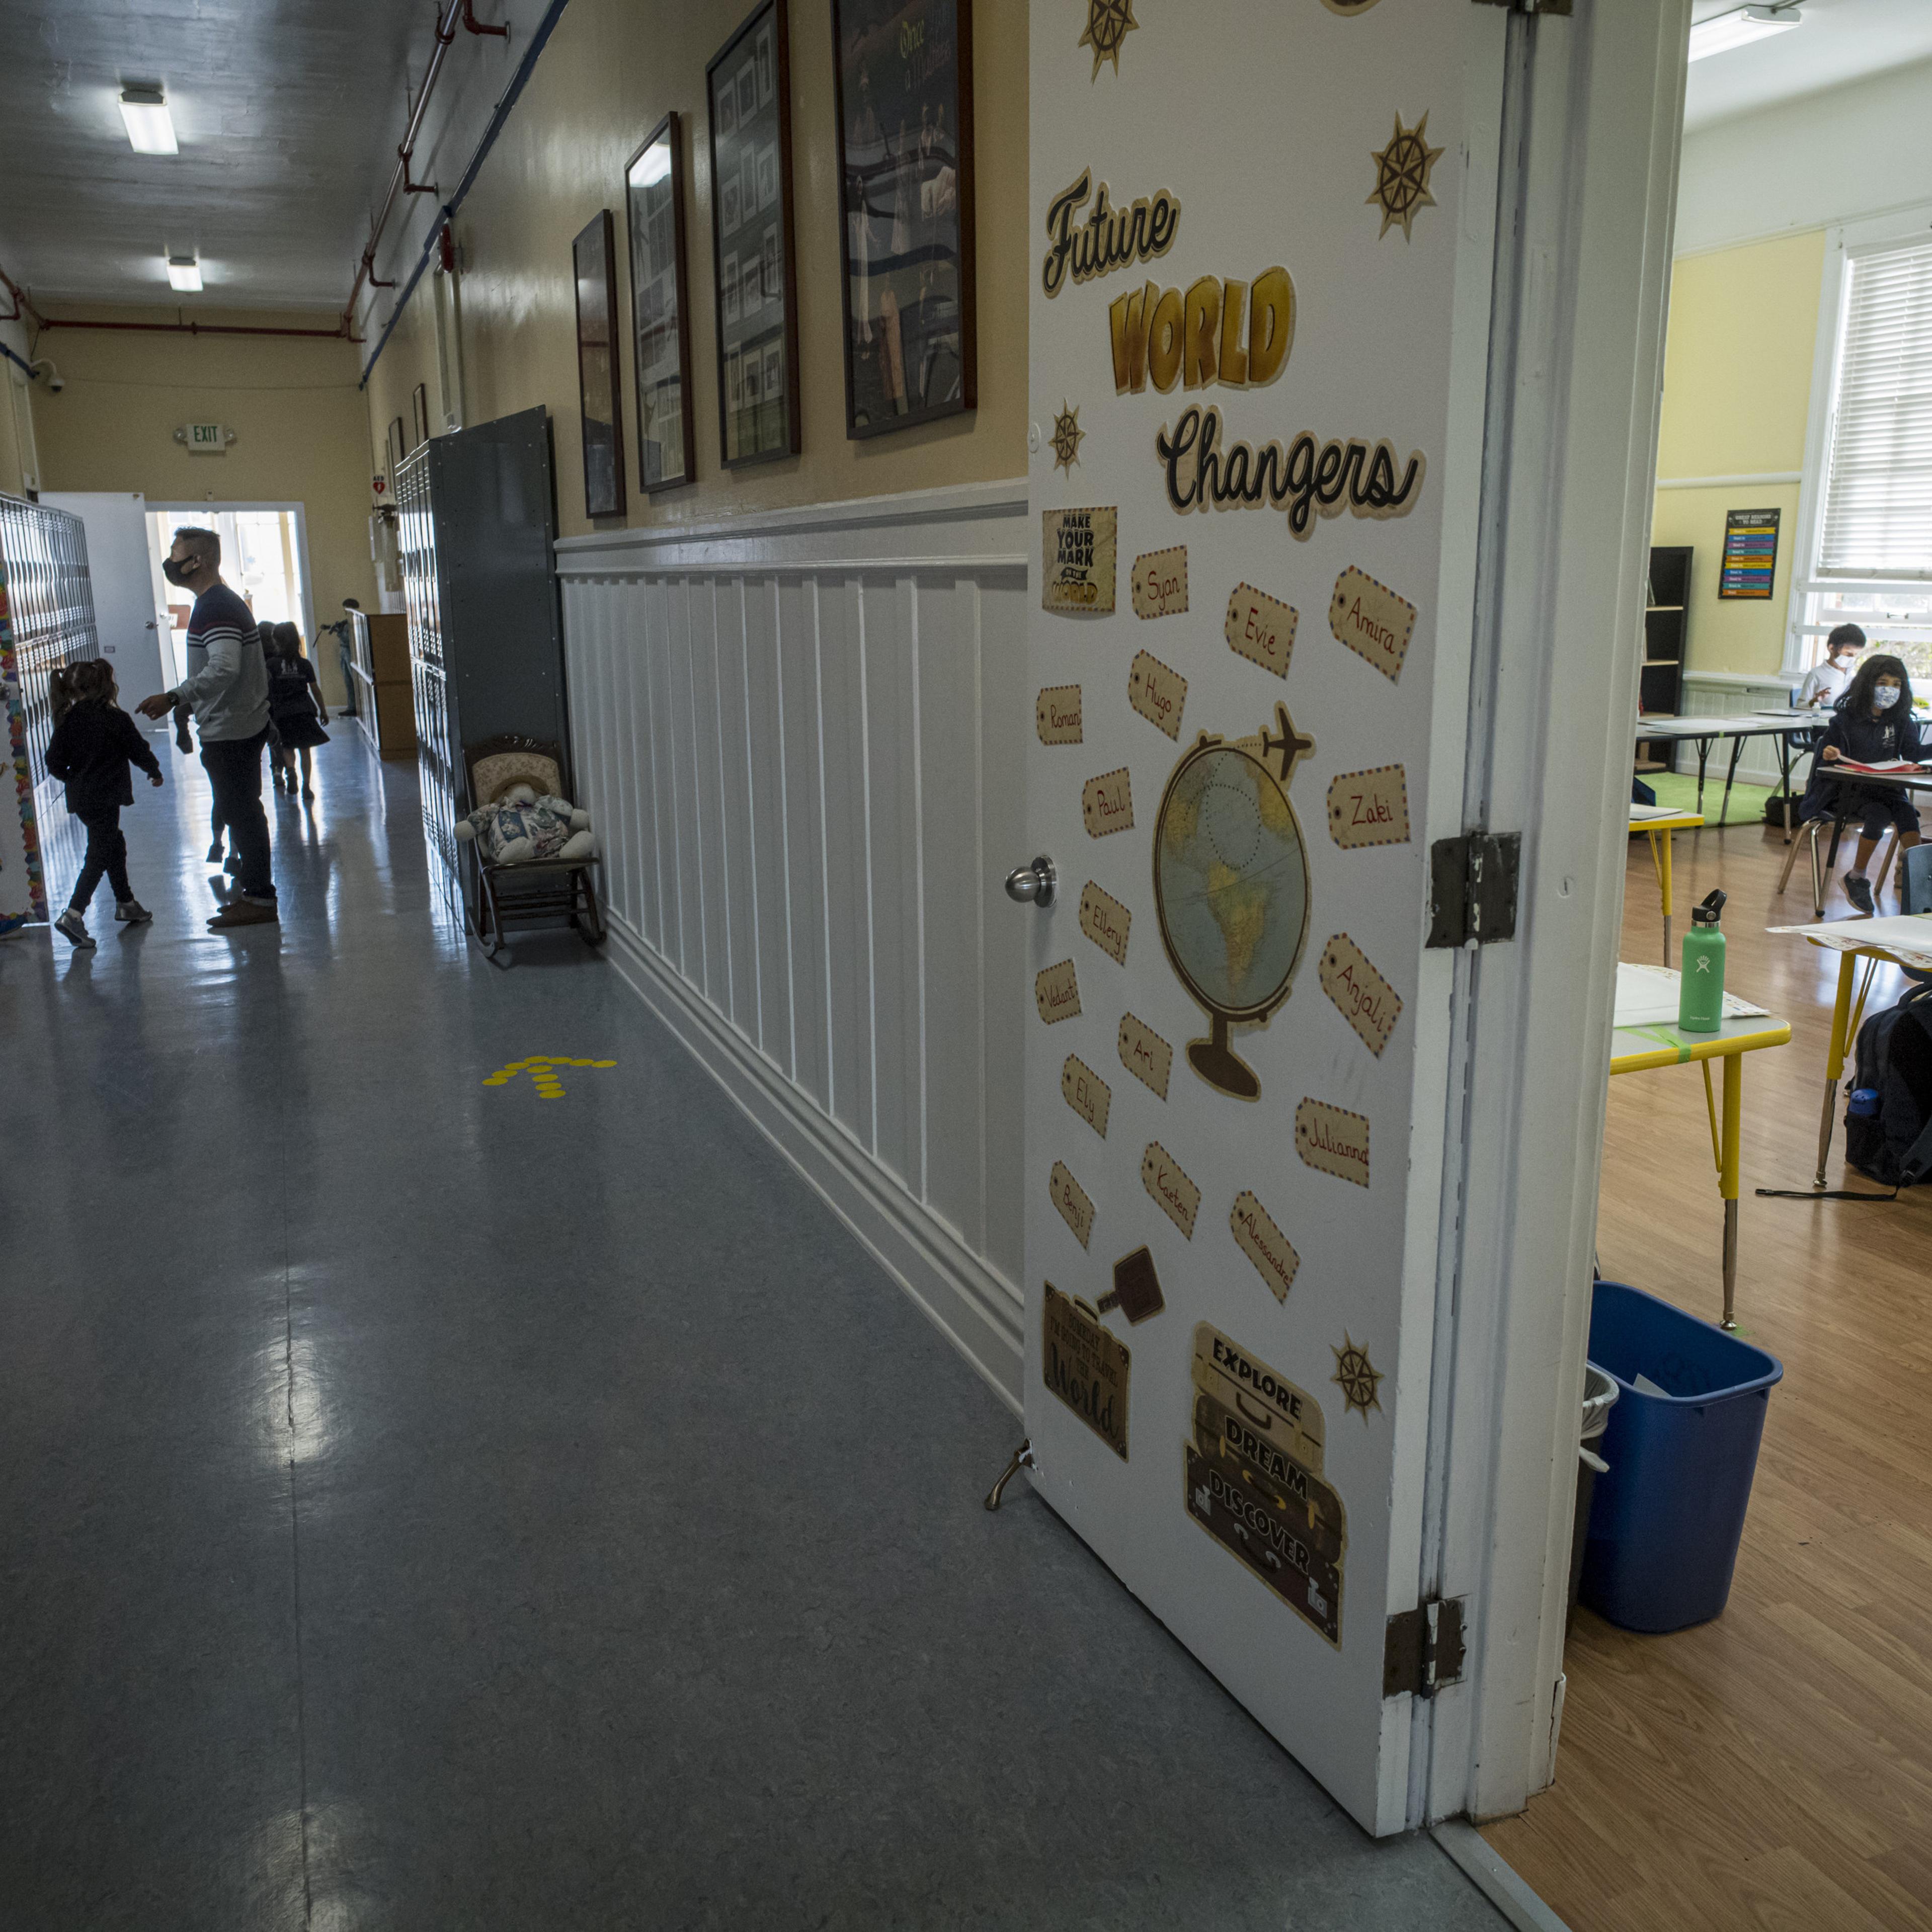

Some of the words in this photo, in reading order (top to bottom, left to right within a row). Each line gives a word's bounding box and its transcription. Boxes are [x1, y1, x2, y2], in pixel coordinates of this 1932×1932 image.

[1044, 175, 1177, 292] Future
[1109, 268, 1293, 390] WORLD
[194, 426, 217, 442] EXIT
[1158, 410, 1418, 533] Changers
[1057, 529, 1094, 549] YOUR
[1063, 515, 1091, 529] MAKE
[1058, 547, 1094, 567] MARK
[1052, 581, 1098, 605] WORLD
[1148, 571, 1179, 610] Syan
[1245, 607, 1275, 655] Evie
[1347, 597, 1395, 654] Amira
[1051, 704, 1081, 729] Roman
[1146, 673, 1171, 719] Hugo
[1097, 787, 1124, 817] Paul
[1351, 793, 1393, 825] Zaki
[1093, 905, 1121, 955] Ellery
[1044, 977, 1075, 1008] Vedant
[1337, 964, 1386, 1031] Anjali
[1134, 1039, 1153, 1071] Ari
[1077, 1077, 1094, 1122] Ely
[1310, 1118, 1369, 1166] Julianna
[1063, 1184, 1084, 1228] Benji
[1069, 1313, 1100, 1351] SOMEDAY
[1061, 1325, 1081, 1354] GOING
[1082, 1343, 1091, 1363] TO
[1092, 1352, 1118, 1387] TRAVEL
[1076, 1357, 1089, 1381] THE
[1213, 1337, 1301, 1420] EXPLORE
[1051, 1342, 1119, 1439] World
[1225, 1415, 1308, 1500] DREAM
[1209, 1469, 1310, 1574] DISCOVER
